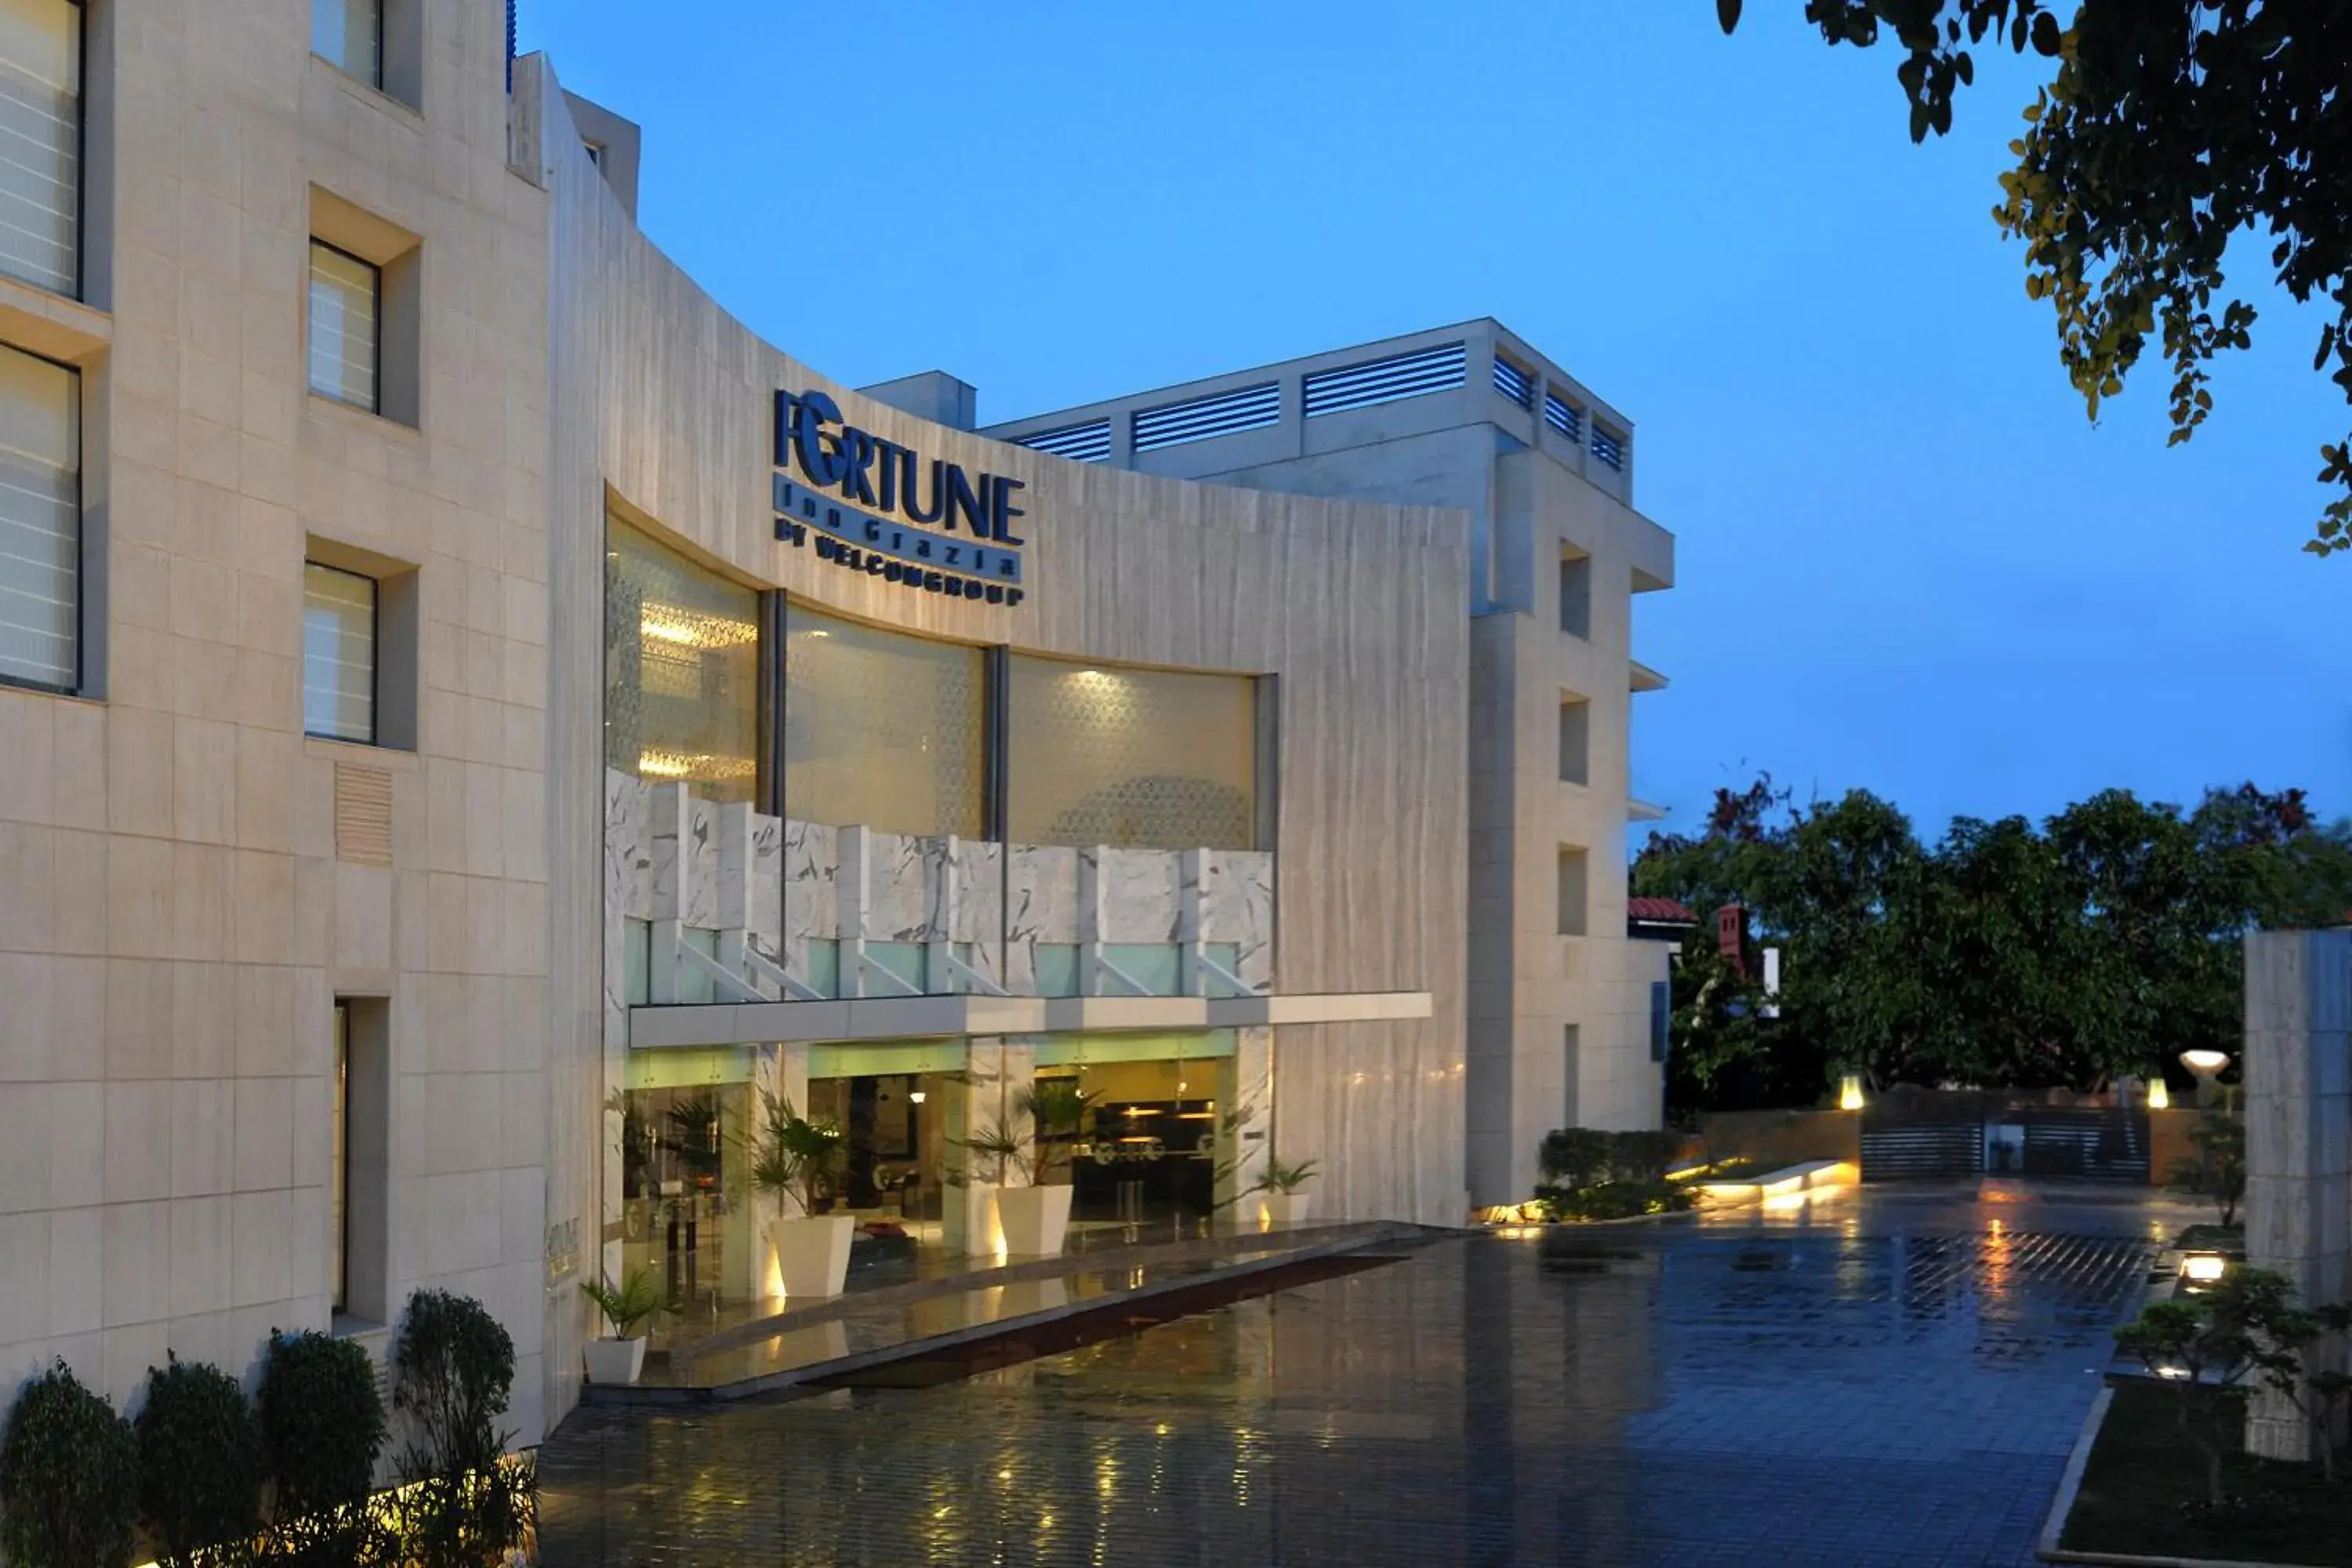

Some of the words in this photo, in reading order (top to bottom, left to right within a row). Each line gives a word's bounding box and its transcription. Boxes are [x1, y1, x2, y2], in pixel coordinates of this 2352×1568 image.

[774, 389, 1025, 546] FORTUNE
[774, 517, 807, 547] BY
[782, 484, 841, 528] Inn
[865, 519, 1015, 576] Grazia
